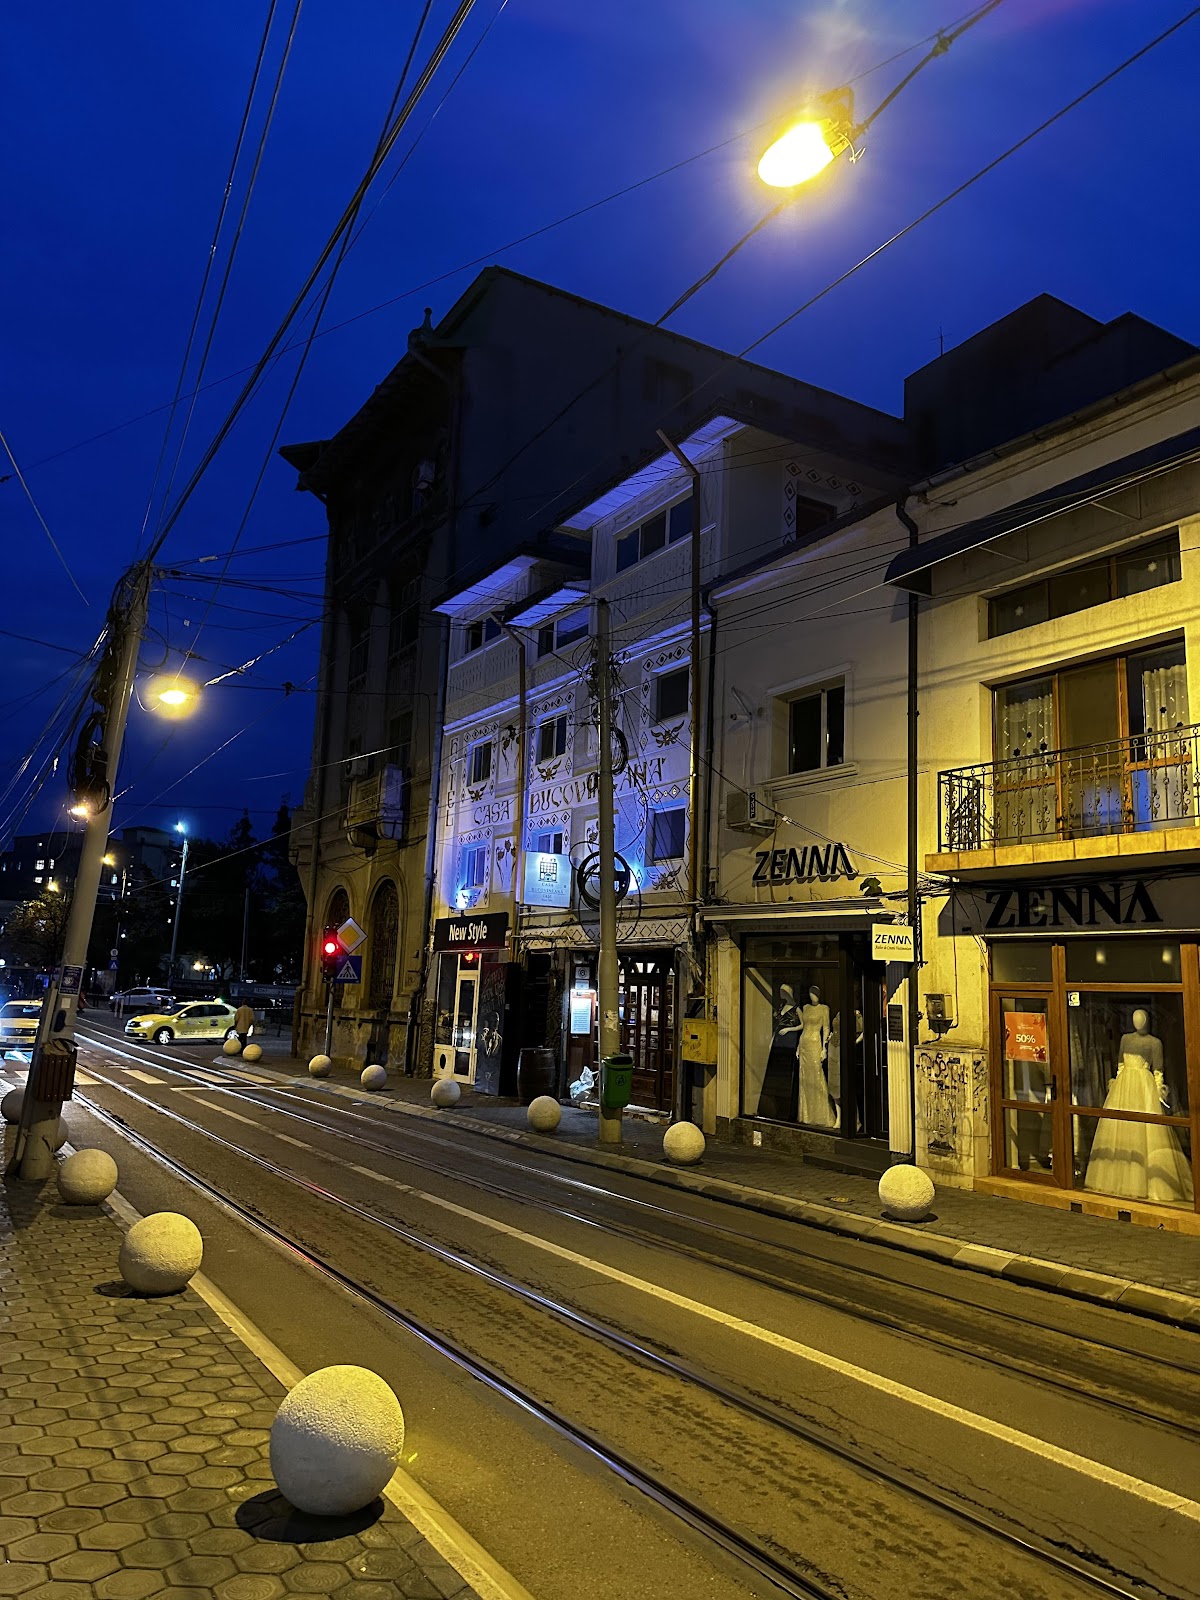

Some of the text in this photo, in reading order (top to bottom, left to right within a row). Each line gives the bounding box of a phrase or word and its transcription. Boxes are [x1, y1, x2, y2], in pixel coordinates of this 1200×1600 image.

[474, 799, 510, 825] CASA
[751, 842, 856, 885] ZENNA
[985, 880, 1164, 929] ZENNA
[448, 920, 488, 945] New Style
[874, 933, 912, 945] ZENNA
[1015, 1033, 1036, 1044] 50%
